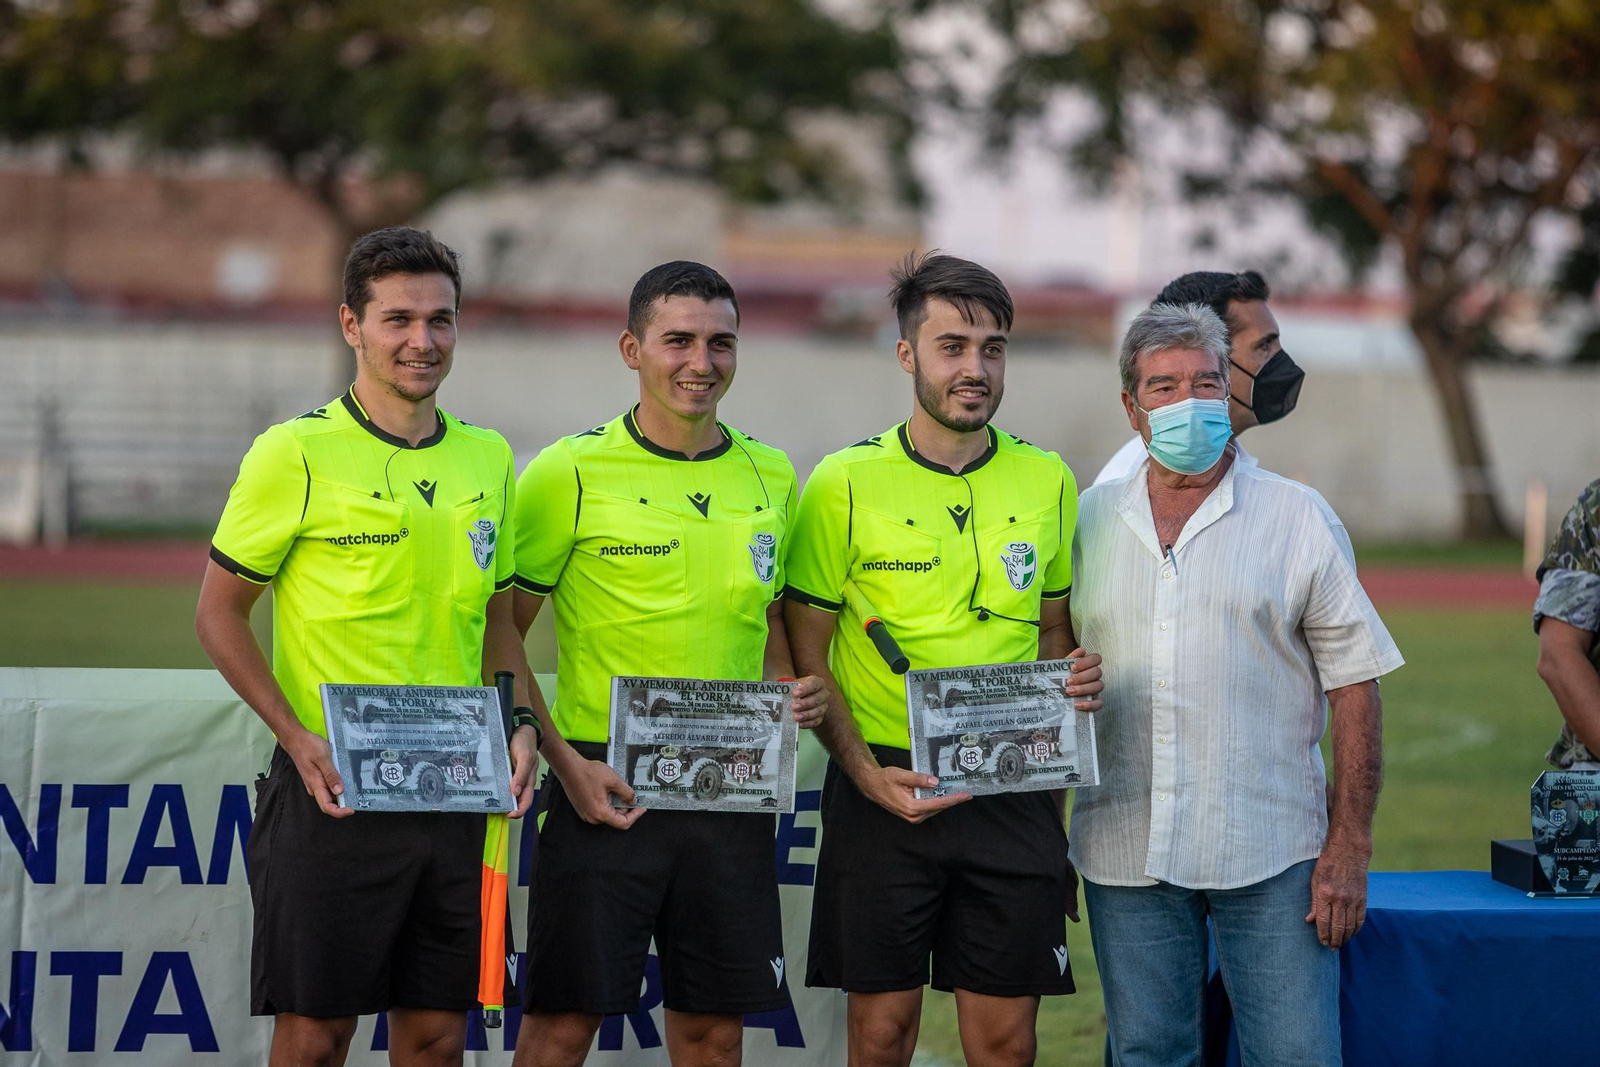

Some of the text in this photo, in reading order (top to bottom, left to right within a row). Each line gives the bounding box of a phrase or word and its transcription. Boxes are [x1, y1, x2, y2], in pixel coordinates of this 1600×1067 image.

[862, 559, 932, 573] matchapp
[913, 673, 927, 682] XV
[930, 669, 988, 681] MEMORIAL
[990, 663, 1032, 676] ANDRÉS
[331, 686, 488, 700] XV MEMORIAL ANDRÉS FRANCO
[622, 679, 790, 694] XV MEMORIAL ANDRÉS FRANCO
[955, 716, 1044, 729] RAFAEL GAVILÁN GARCÍA
[687, 732, 718, 742] ÁLVAREZ
[1038, 765, 1074, 774] DEPORTIVO
